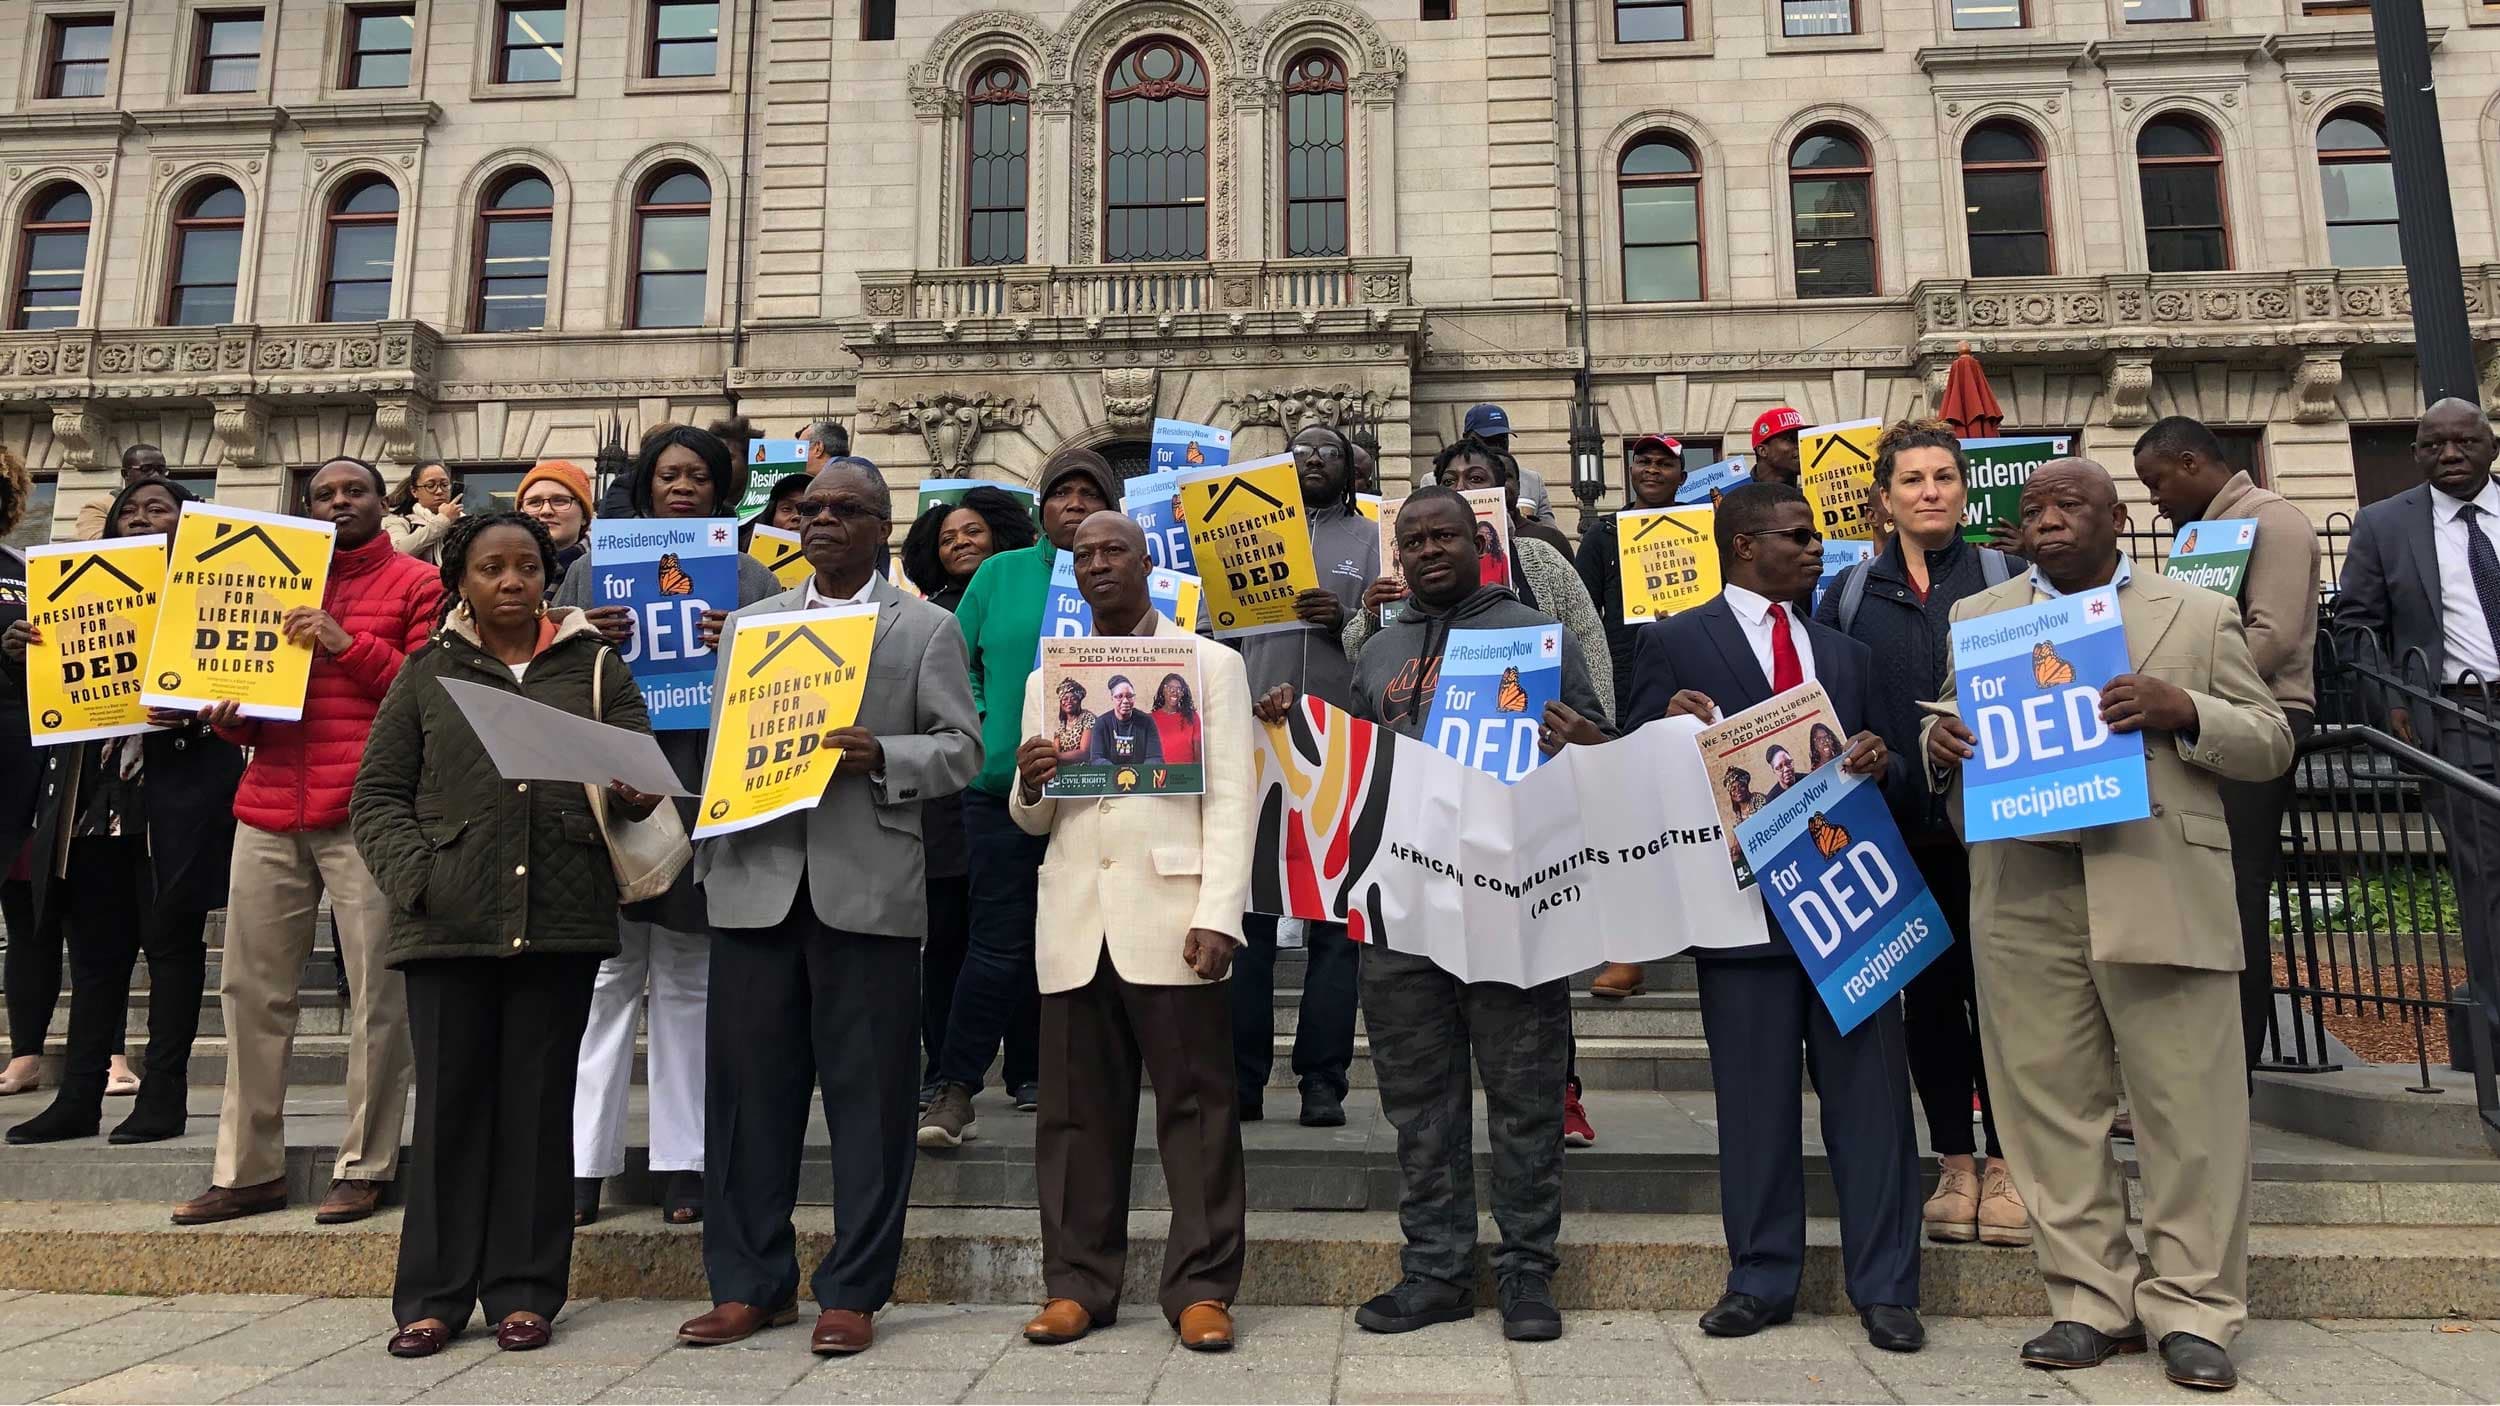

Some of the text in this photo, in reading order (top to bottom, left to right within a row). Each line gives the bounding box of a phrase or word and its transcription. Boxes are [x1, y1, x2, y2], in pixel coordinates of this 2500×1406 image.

[1156, 427, 1209, 439] #ResidencyNow
[1157, 448, 1174, 462] for
[1805, 461, 1876, 486] #RESIDENCYNO
[1831, 480, 1849, 491] FOR
[1130, 480, 1178, 497] #Residency
[1136, 512, 1156, 528] for
[1194, 506, 1296, 545] #RESIDENCYNOW
[1831, 522, 1871, 540] HOLDER
[597, 530, 695, 550] #ResidencyNow
[1144, 526, 1190, 570] DE
[1235, 534, 1258, 549] FOR
[1623, 534, 1709, 556] #RESIDENCYNOW
[1222, 542, 1285, 569] LIBERIAN
[1644, 556, 1696, 573] LIBERIAN
[1656, 550, 1675, 560] FOR
[173, 572, 312, 590] #RESIDENCYNOW
[603, 574, 635, 599] for
[1227, 561, 1290, 591] DED
[1646, 569, 1698, 590] DED
[225, 591, 253, 604] FOR
[1057, 593, 1085, 614] for
[1238, 585, 1295, 607] HOLDERS
[1652, 585, 1700, 601] HOLDERS
[33, 592, 156, 626] #RESIDENCYNOW
[199, 607, 281, 624] LIBERIAN
[80, 618, 106, 635] FOR
[1960, 611, 2069, 653] #ResidencyNow
[61, 630, 136, 656] LIBERIAN
[195, 629, 278, 651] DED
[1450, 641, 1533, 661] #ResidencyNow
[62, 651, 138, 683] DED
[198, 658, 275, 673] HOLDERS
[1079, 655, 1103, 663] DED
[71, 679, 141, 704] HOLDERS
[728, 666, 856, 705] #RESIDENCYNOW
[1445, 685, 1476, 711] for
[1970, 675, 2006, 702] for
[773, 696, 800, 714] FOR
[750, 709, 826, 739] LIBERIAN
[1976, 685, 2108, 770] DED
[745, 733, 820, 770] DED
[1437, 717, 1540, 782] DED
[1732, 732, 1754, 746] DED
[745, 761, 811, 792] HOLDERS
[1991, 774, 2121, 821] recipients
[1748, 778, 1830, 854] #ResidencyNow
[1390, 825, 1723, 898] AFRICAN COMMUNITIES TOGETHER
[1771, 859, 1803, 897] for
[1531, 885, 1582, 919] (ACT)
[1788, 841, 1898, 960] DED
[1842, 916, 1929, 1004] recipients
